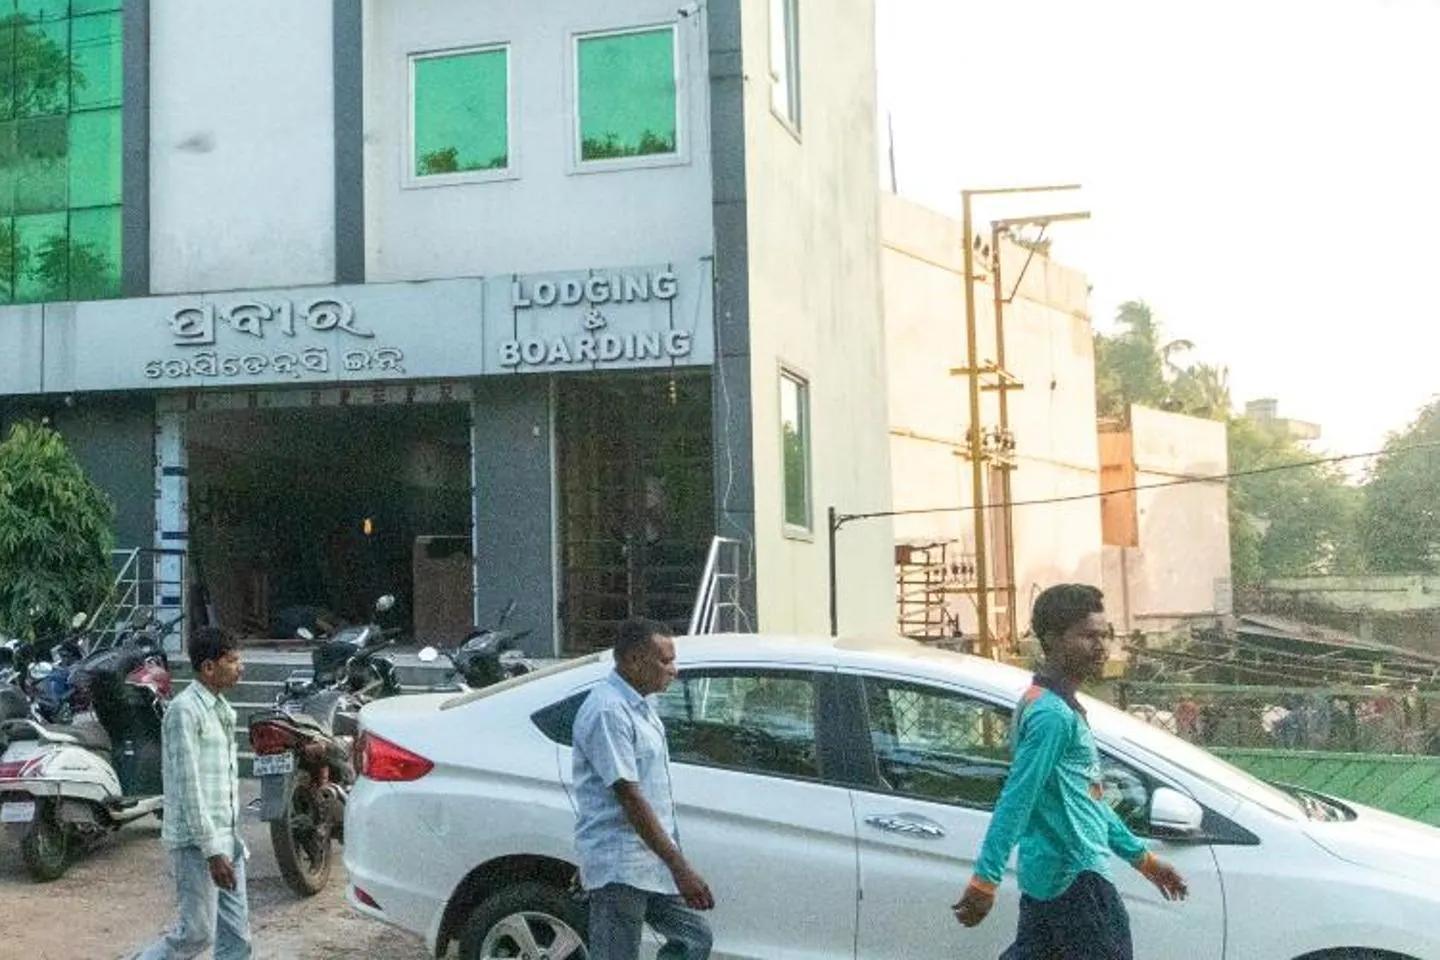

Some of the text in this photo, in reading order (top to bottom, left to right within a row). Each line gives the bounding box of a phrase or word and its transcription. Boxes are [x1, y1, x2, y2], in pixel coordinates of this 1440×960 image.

[511, 271, 678, 310] LODGING
[585, 307, 607, 330] &
[499, 328, 692, 368] BOARDING
